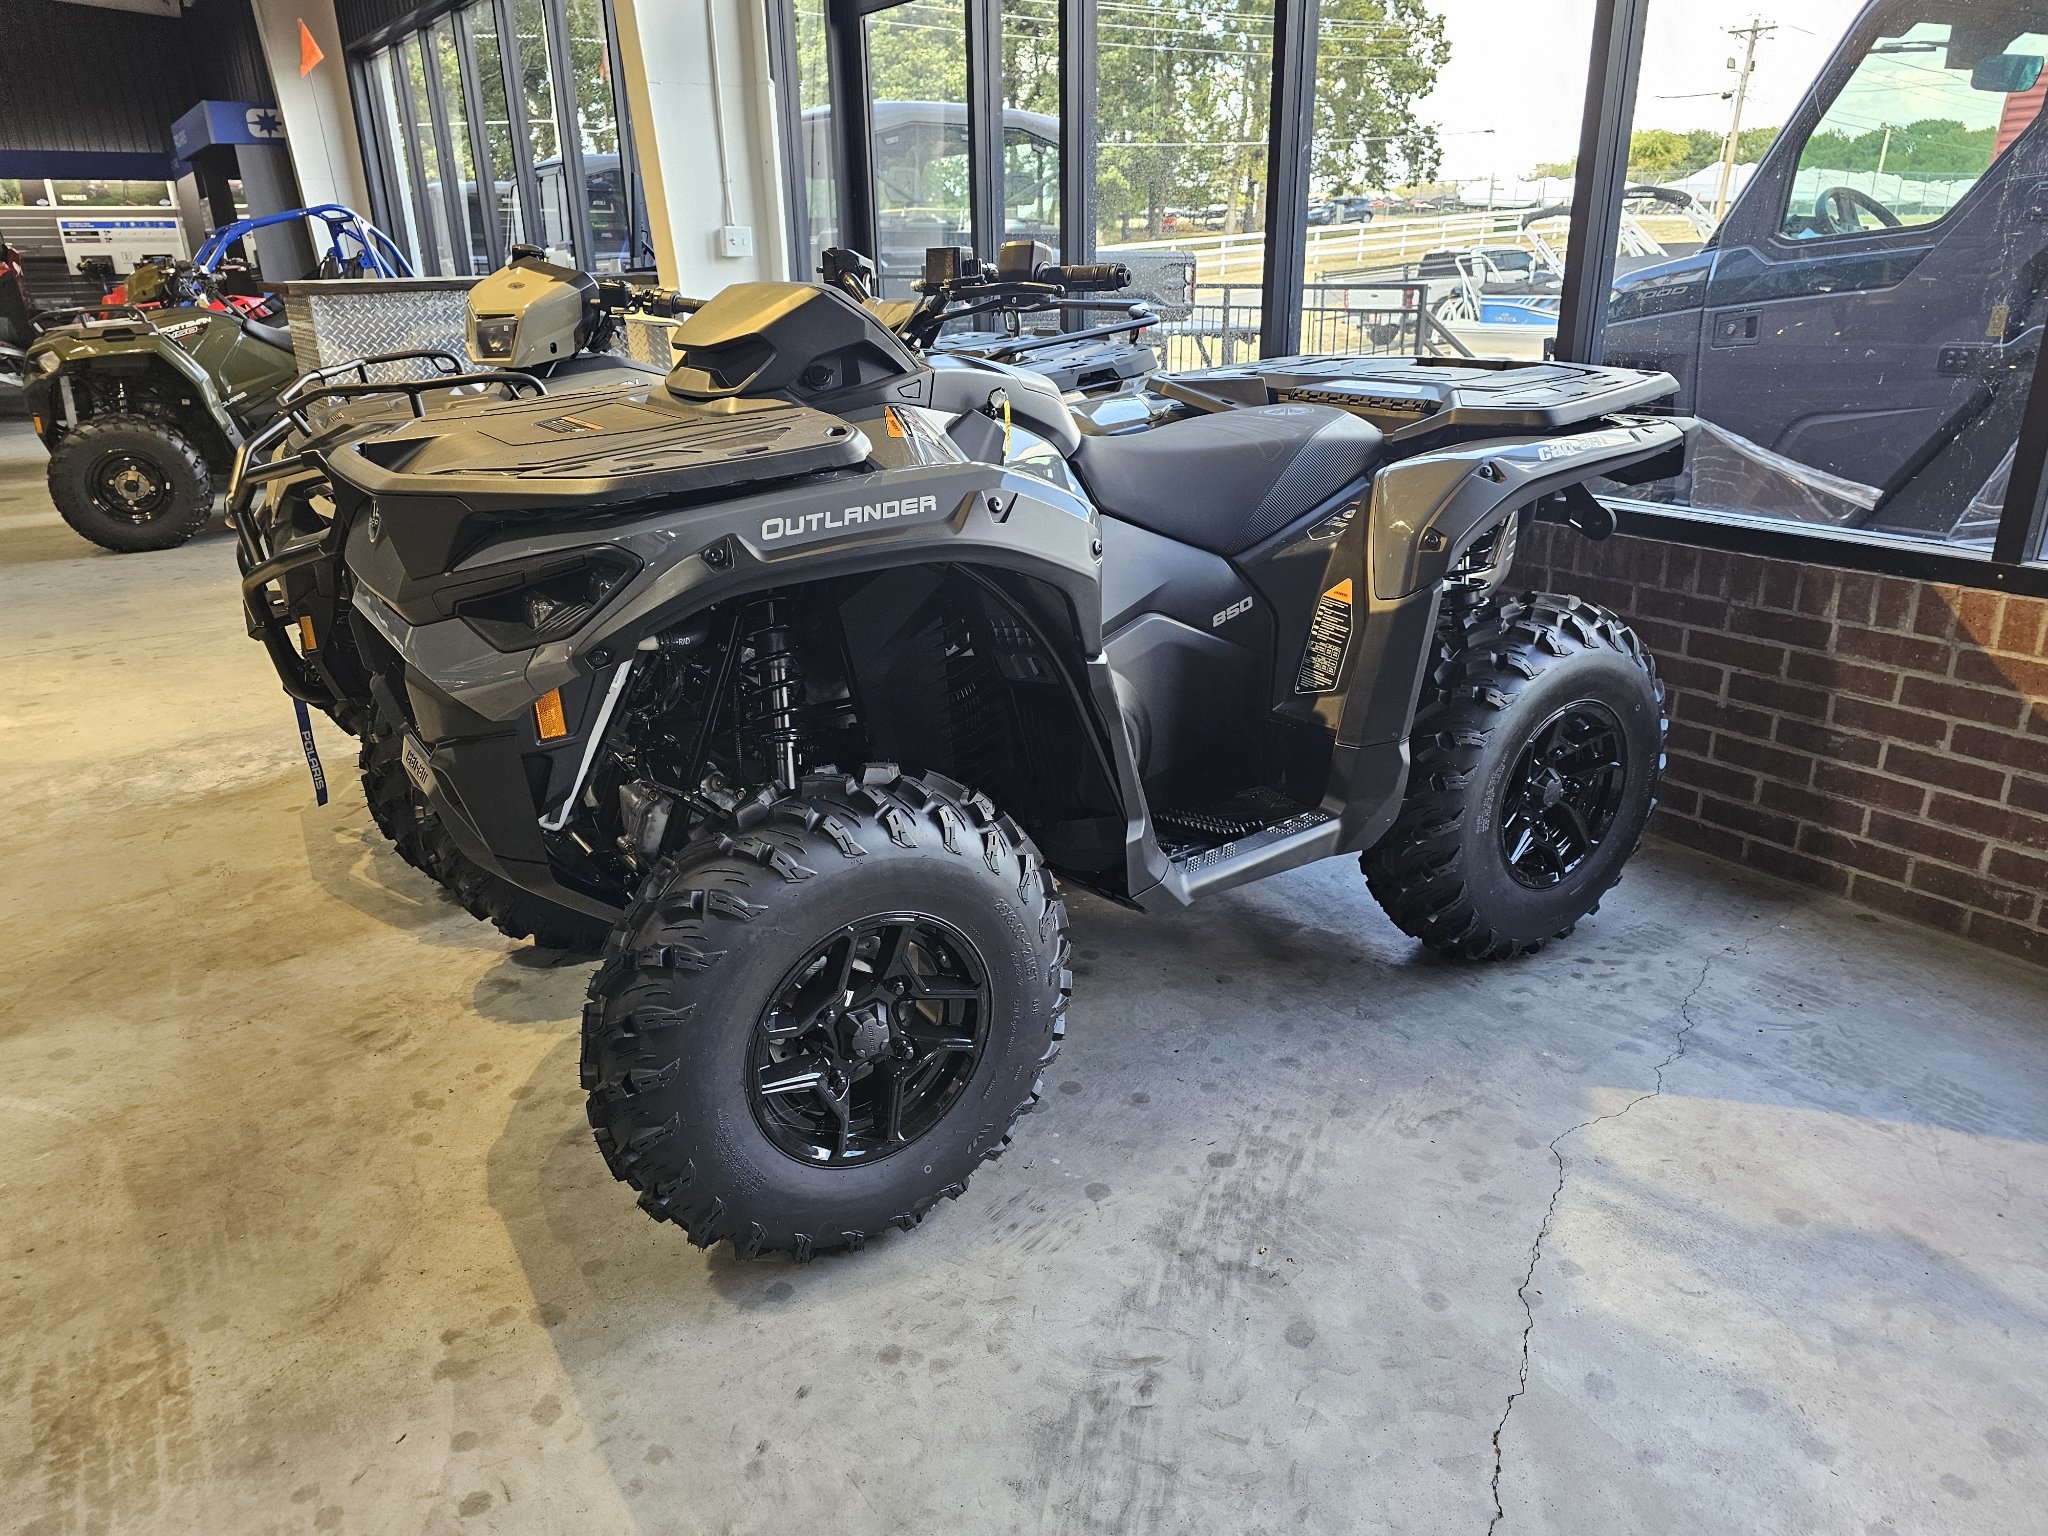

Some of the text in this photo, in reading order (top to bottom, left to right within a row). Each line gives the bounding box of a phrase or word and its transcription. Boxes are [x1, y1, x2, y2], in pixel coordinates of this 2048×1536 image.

[761, 494, 937, 541] OUTLANDER
[1212, 595, 1254, 628] 850
[301, 730, 326, 790] POLARIS
